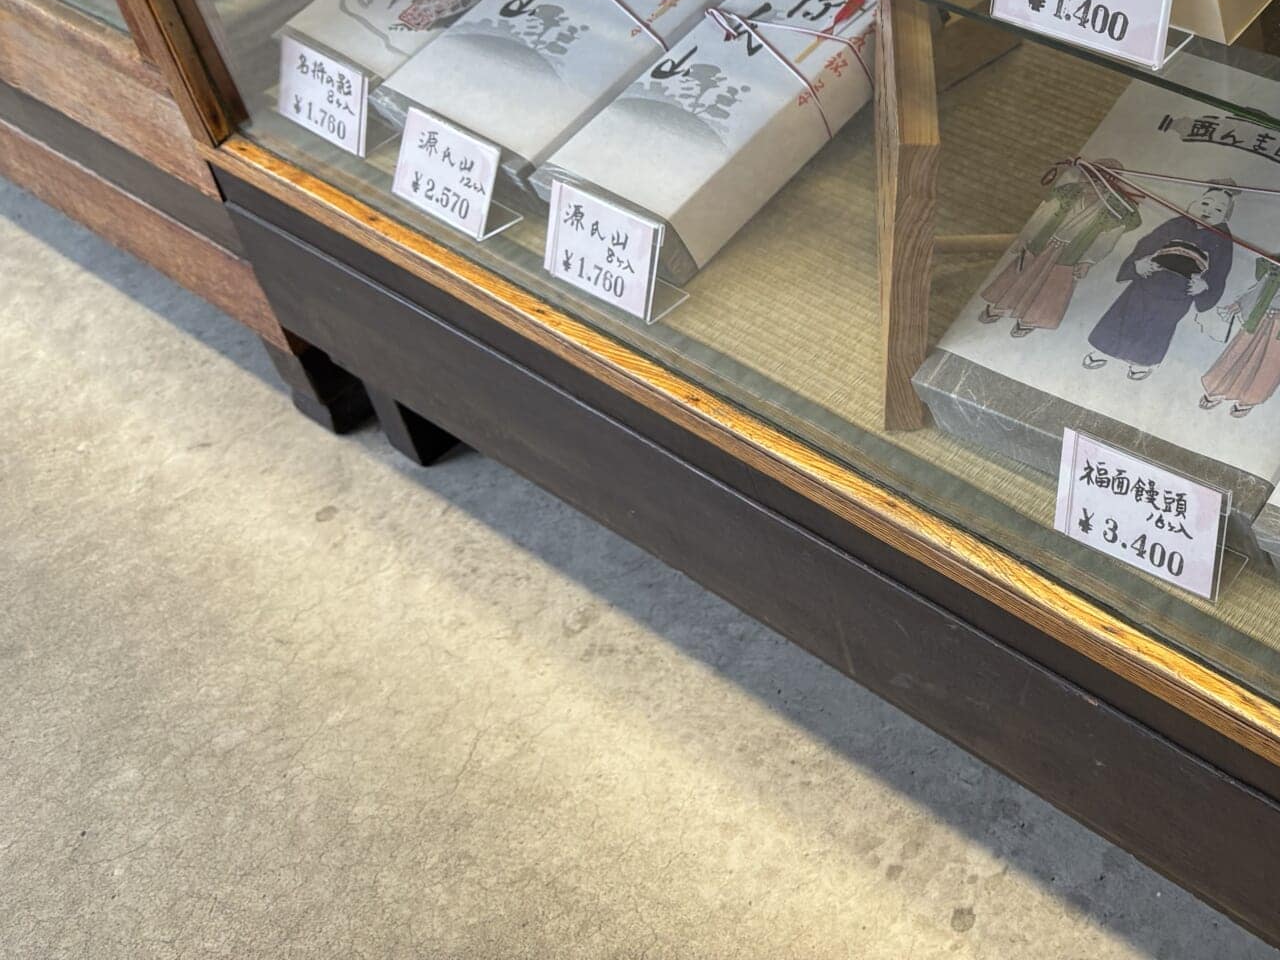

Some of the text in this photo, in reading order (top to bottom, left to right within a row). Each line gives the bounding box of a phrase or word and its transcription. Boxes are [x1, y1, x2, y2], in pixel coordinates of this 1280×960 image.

[418, 130, 475, 173] 源氏山
[563, 202, 629, 250] 源氏山
[1079, 459, 1188, 520] 福面饅頭
